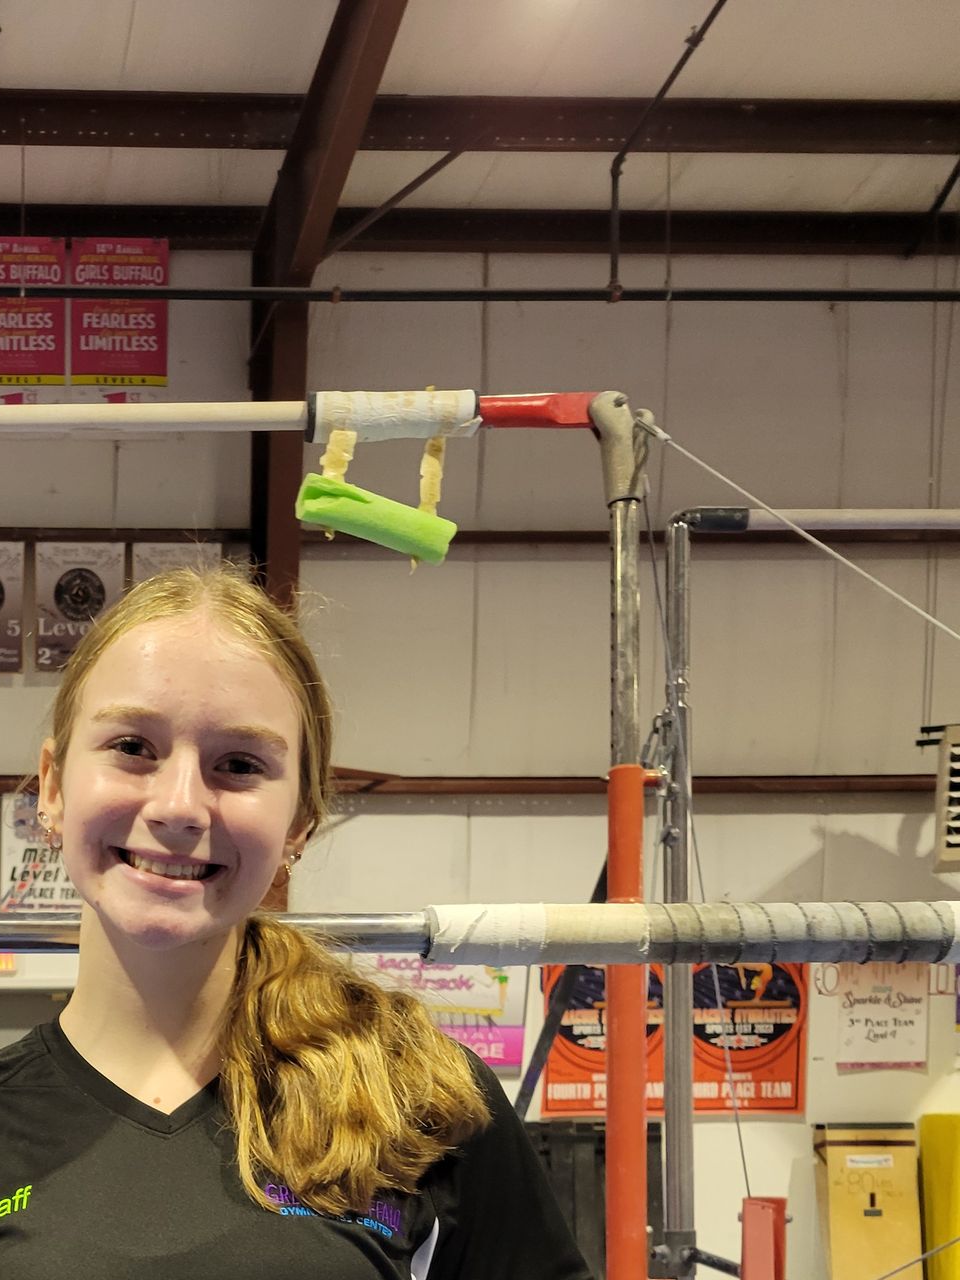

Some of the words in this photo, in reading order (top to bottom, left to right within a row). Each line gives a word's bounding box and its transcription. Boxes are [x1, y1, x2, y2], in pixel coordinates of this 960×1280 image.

[10, 264, 61, 282] BUFFALO
[75, 264, 109, 282] GIRLS
[112, 265, 164, 283] BUFFALO
[82, 313, 156, 329] FEARLESS
[79, 335, 158, 351] LIMITLESS
[6, 619, 21, 637] 5
[10, 866, 60, 882] Level
[28, 887, 56, 899] PLACE
[864, 1017, 889, 1028] PLACE
[893, 1017, 915, 1028] TEAM
[547, 1081, 592, 1099] FOURTH
[721, 1081, 756, 1098] PLACE
[761, 1081, 792, 1098] TEAM
[356, 1216, 393, 1239] CENTER
